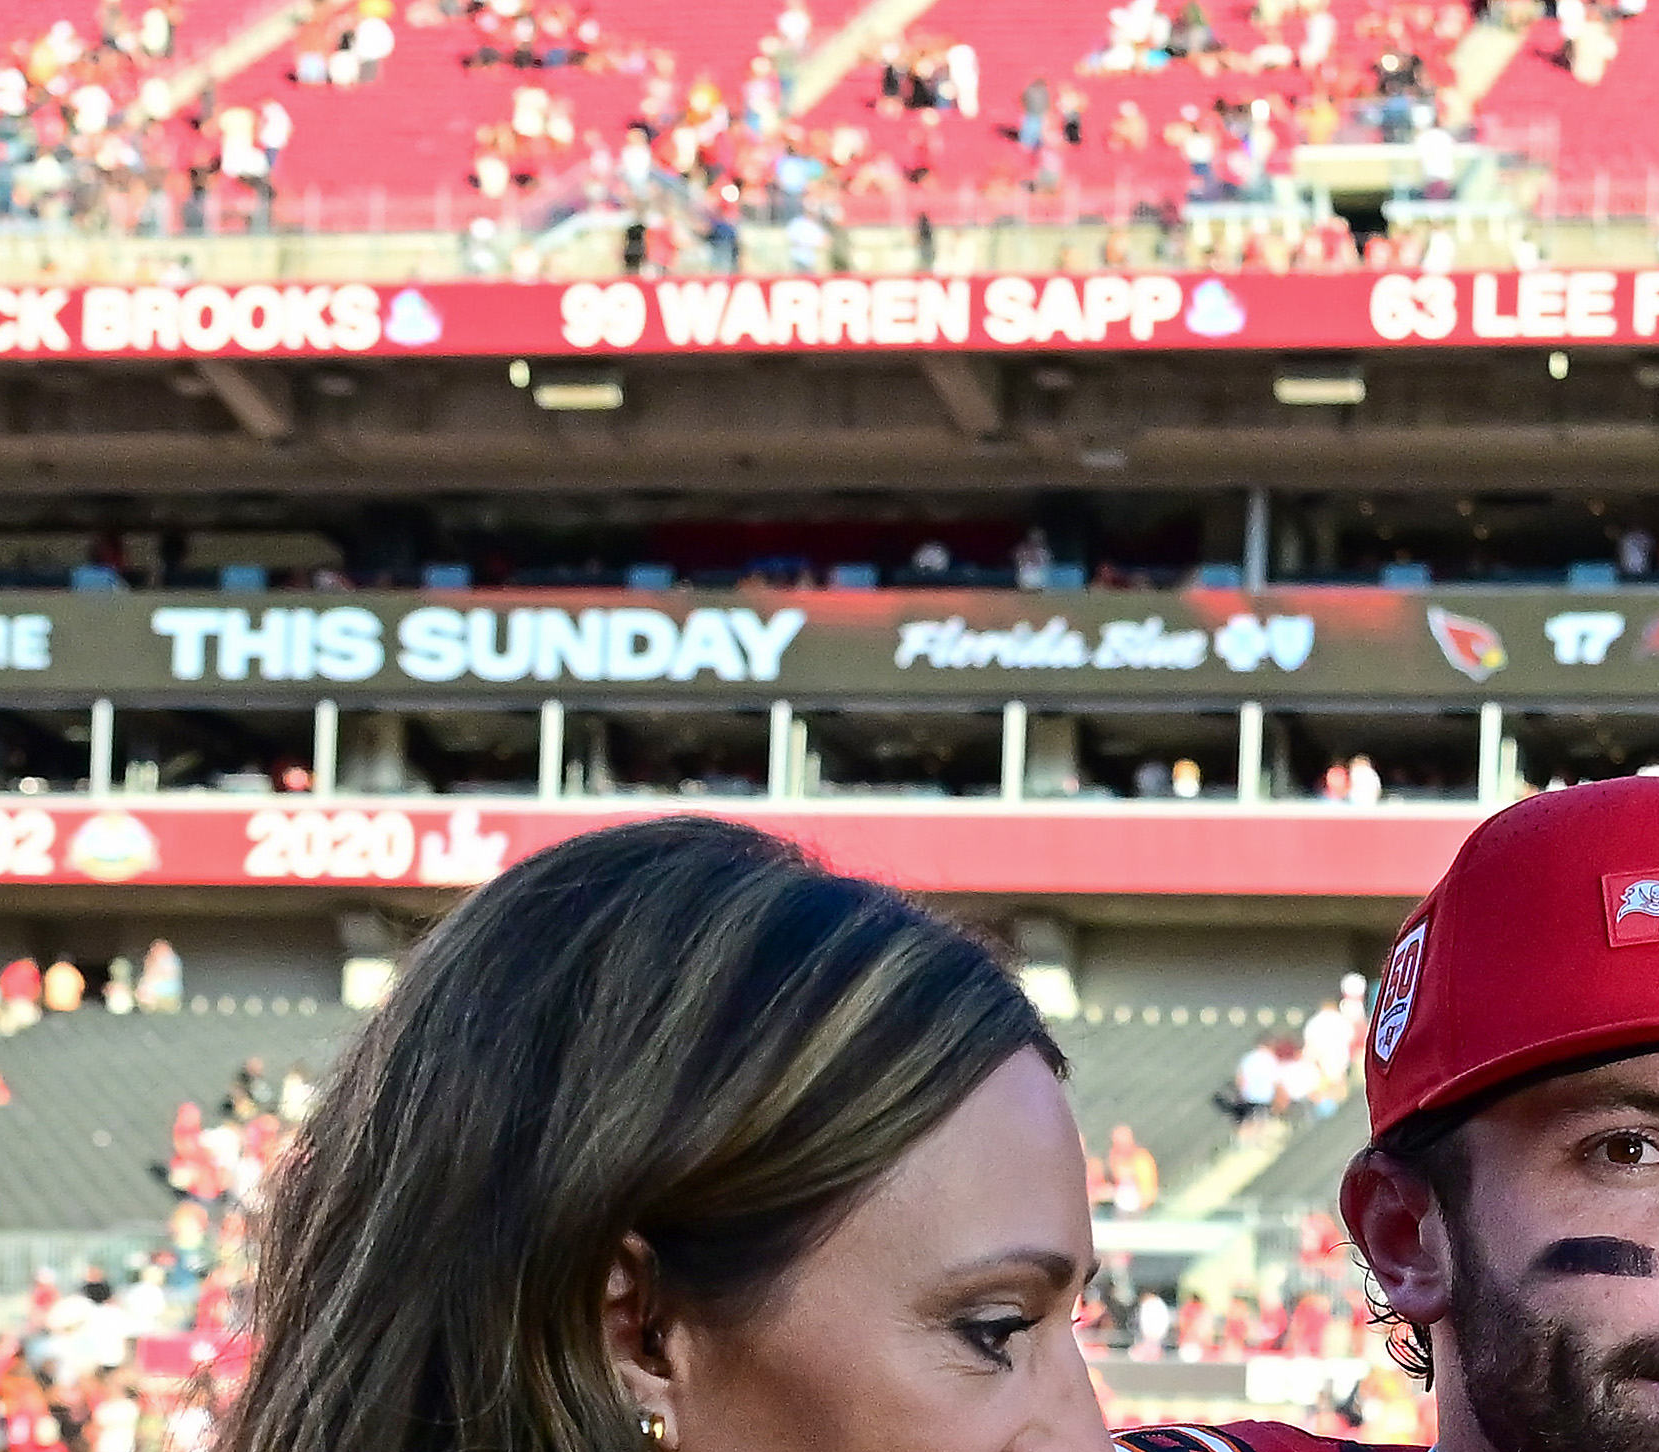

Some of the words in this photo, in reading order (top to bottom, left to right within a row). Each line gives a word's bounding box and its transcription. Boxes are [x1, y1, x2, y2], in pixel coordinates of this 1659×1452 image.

[81, 284, 381, 353] BROOKS
[559, 281, 647, 349] 99
[656, 279, 971, 346] WARREN
[982, 275, 1183, 344] SAPP
[1369, 275, 1457, 343] 63
[1473, 273, 1617, 339] LEE
[153, 607, 383, 681] THIS
[397, 606, 805, 682] SUNDAY
[1545, 612, 1626, 665] 17
[246, 812, 415, 879] 2020
